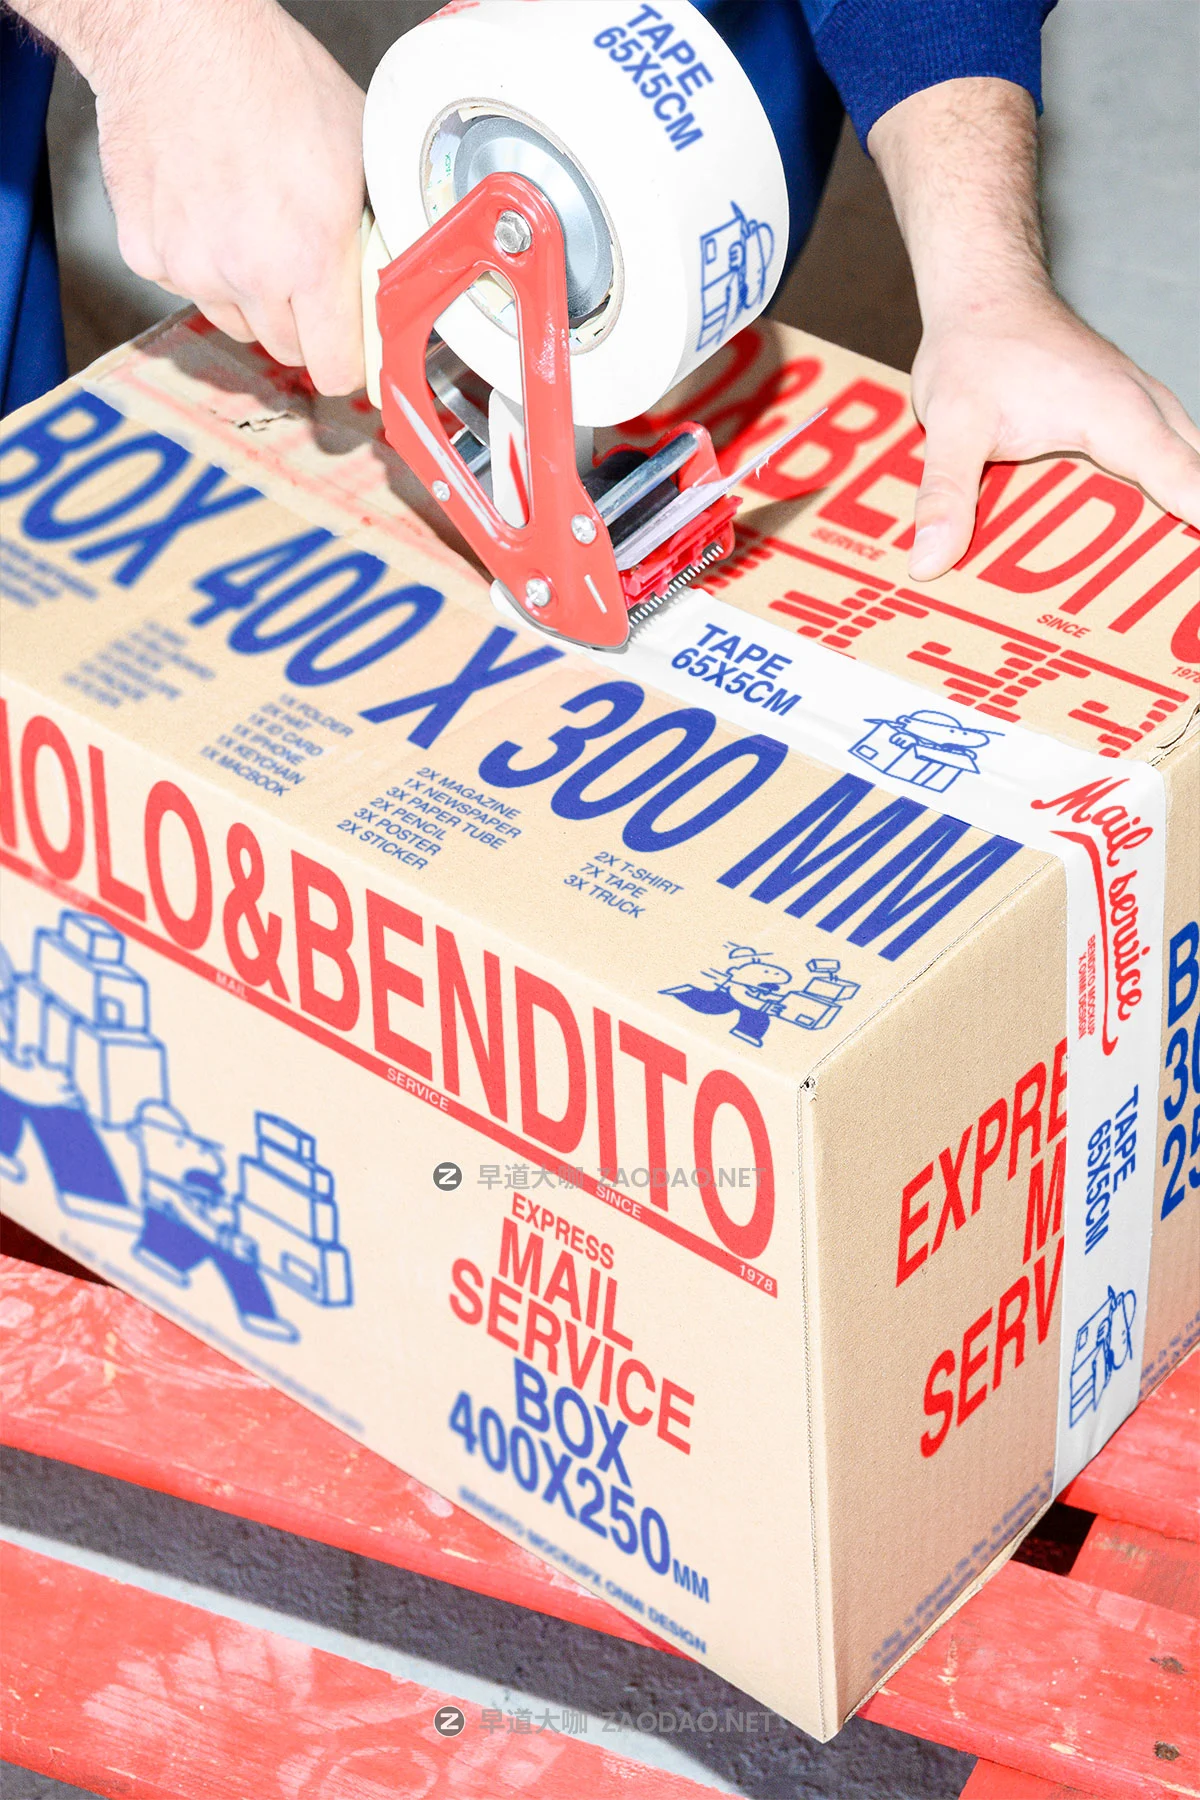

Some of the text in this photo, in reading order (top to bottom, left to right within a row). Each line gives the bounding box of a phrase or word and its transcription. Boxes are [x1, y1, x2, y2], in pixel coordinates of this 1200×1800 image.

[627, 3, 714, 97] TAPE
[593, 25, 704, 152] 65X5CM
[810, 526, 887, 561] SERVICE
[696, 623, 794, 681] TAPE
[1036, 613, 1091, 639] SINCE
[0, 388, 1024, 961] BOX 400 X 300 MM
[670, 647, 802, 717] 65X5CM
[234, 743, 306, 785] KEYCHAIN
[281, 732, 324, 757] CARD
[217, 755, 290, 797] MACBOOK
[416, 767, 522, 820] 2X MAGAZINE
[354, 808, 442, 856] 3X POSTER
[370, 797, 447, 841] 2X PENCIL
[386, 786, 507, 850] 3X PAPER TUBE
[403, 777, 522, 839] 1X NEWSPAPER
[1031, 776, 1154, 868] Mail
[336, 819, 429, 870] 2X STICKER
[564, 874, 646, 918] 3X TRUCK
[580, 862, 648, 899] 7X TAPE
[594, 851, 685, 895] 2X T-SHIRT
[0, 697, 775, 1259] OLO&BENDITO
[216, 971, 248, 999] MAIL
[1087, 933, 1096, 987] BENDITO
[387, 1067, 450, 1112] SERVICE
[896, 1037, 1067, 1288] EXPRE
[1113, 1084, 1139, 1194] TAPE
[595, 1185, 642, 1220] SINCE
[1085, 1119, 1112, 1256] 65X5CM
[512, 1192, 615, 1270] EXPRESS
[499, 1217, 633, 1352] MAIL
[739, 1264, 773, 1291] 1978
[448, 1258, 695, 1456] SERVICE
[920, 1235, 1064, 1459] SERV
[513, 1357, 633, 1489] BOX
[648, 1606, 707, 1654] DESIGN
